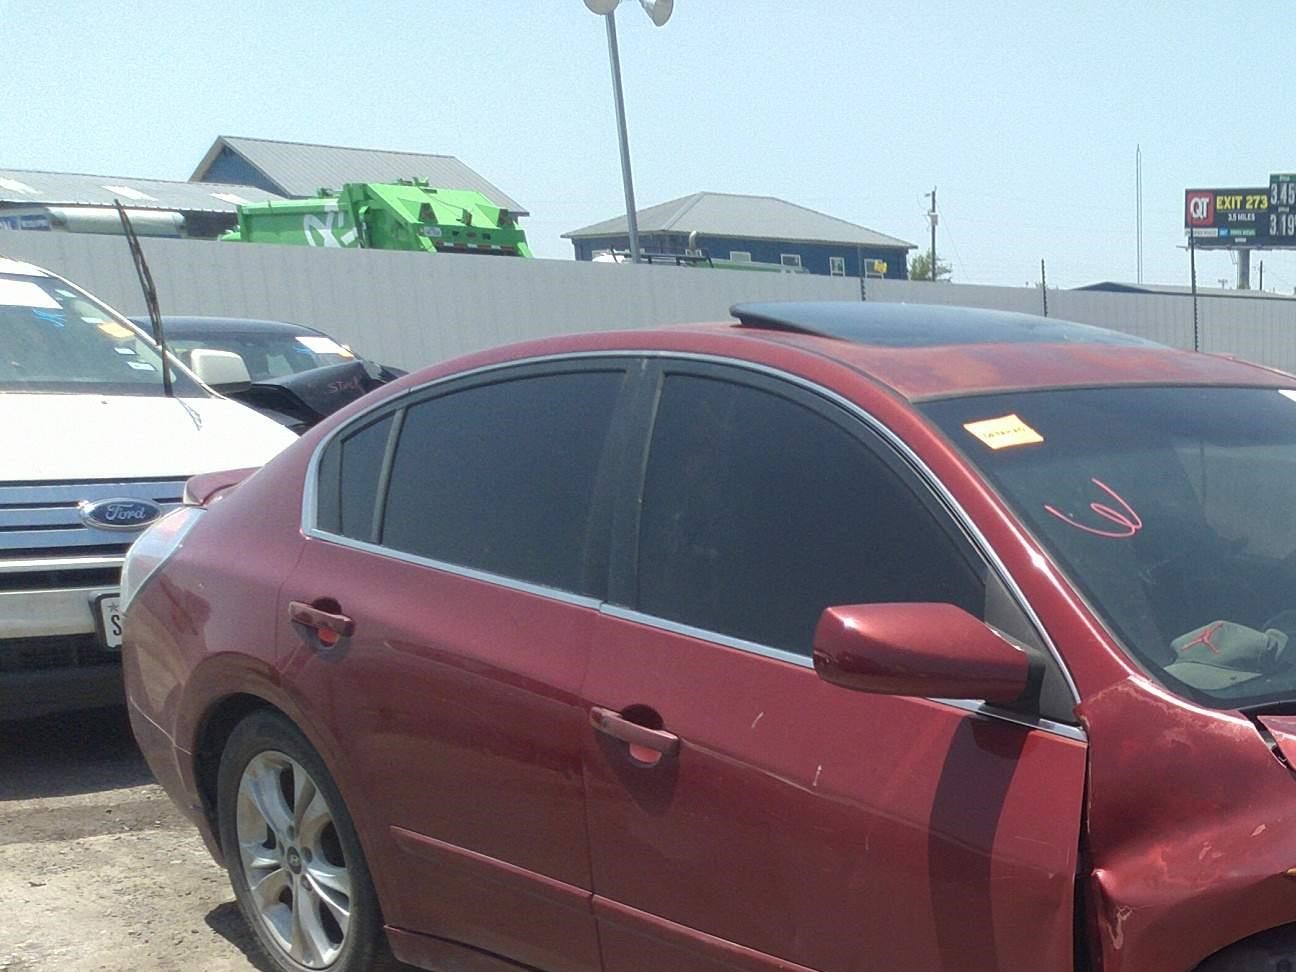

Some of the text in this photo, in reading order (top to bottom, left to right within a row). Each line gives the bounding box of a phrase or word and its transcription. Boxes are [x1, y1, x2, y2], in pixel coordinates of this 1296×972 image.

[1190, 197, 1209, 219] QT
[1216, 194, 1268, 209] EXIT 273
[105, 503, 146, 521] Ford
